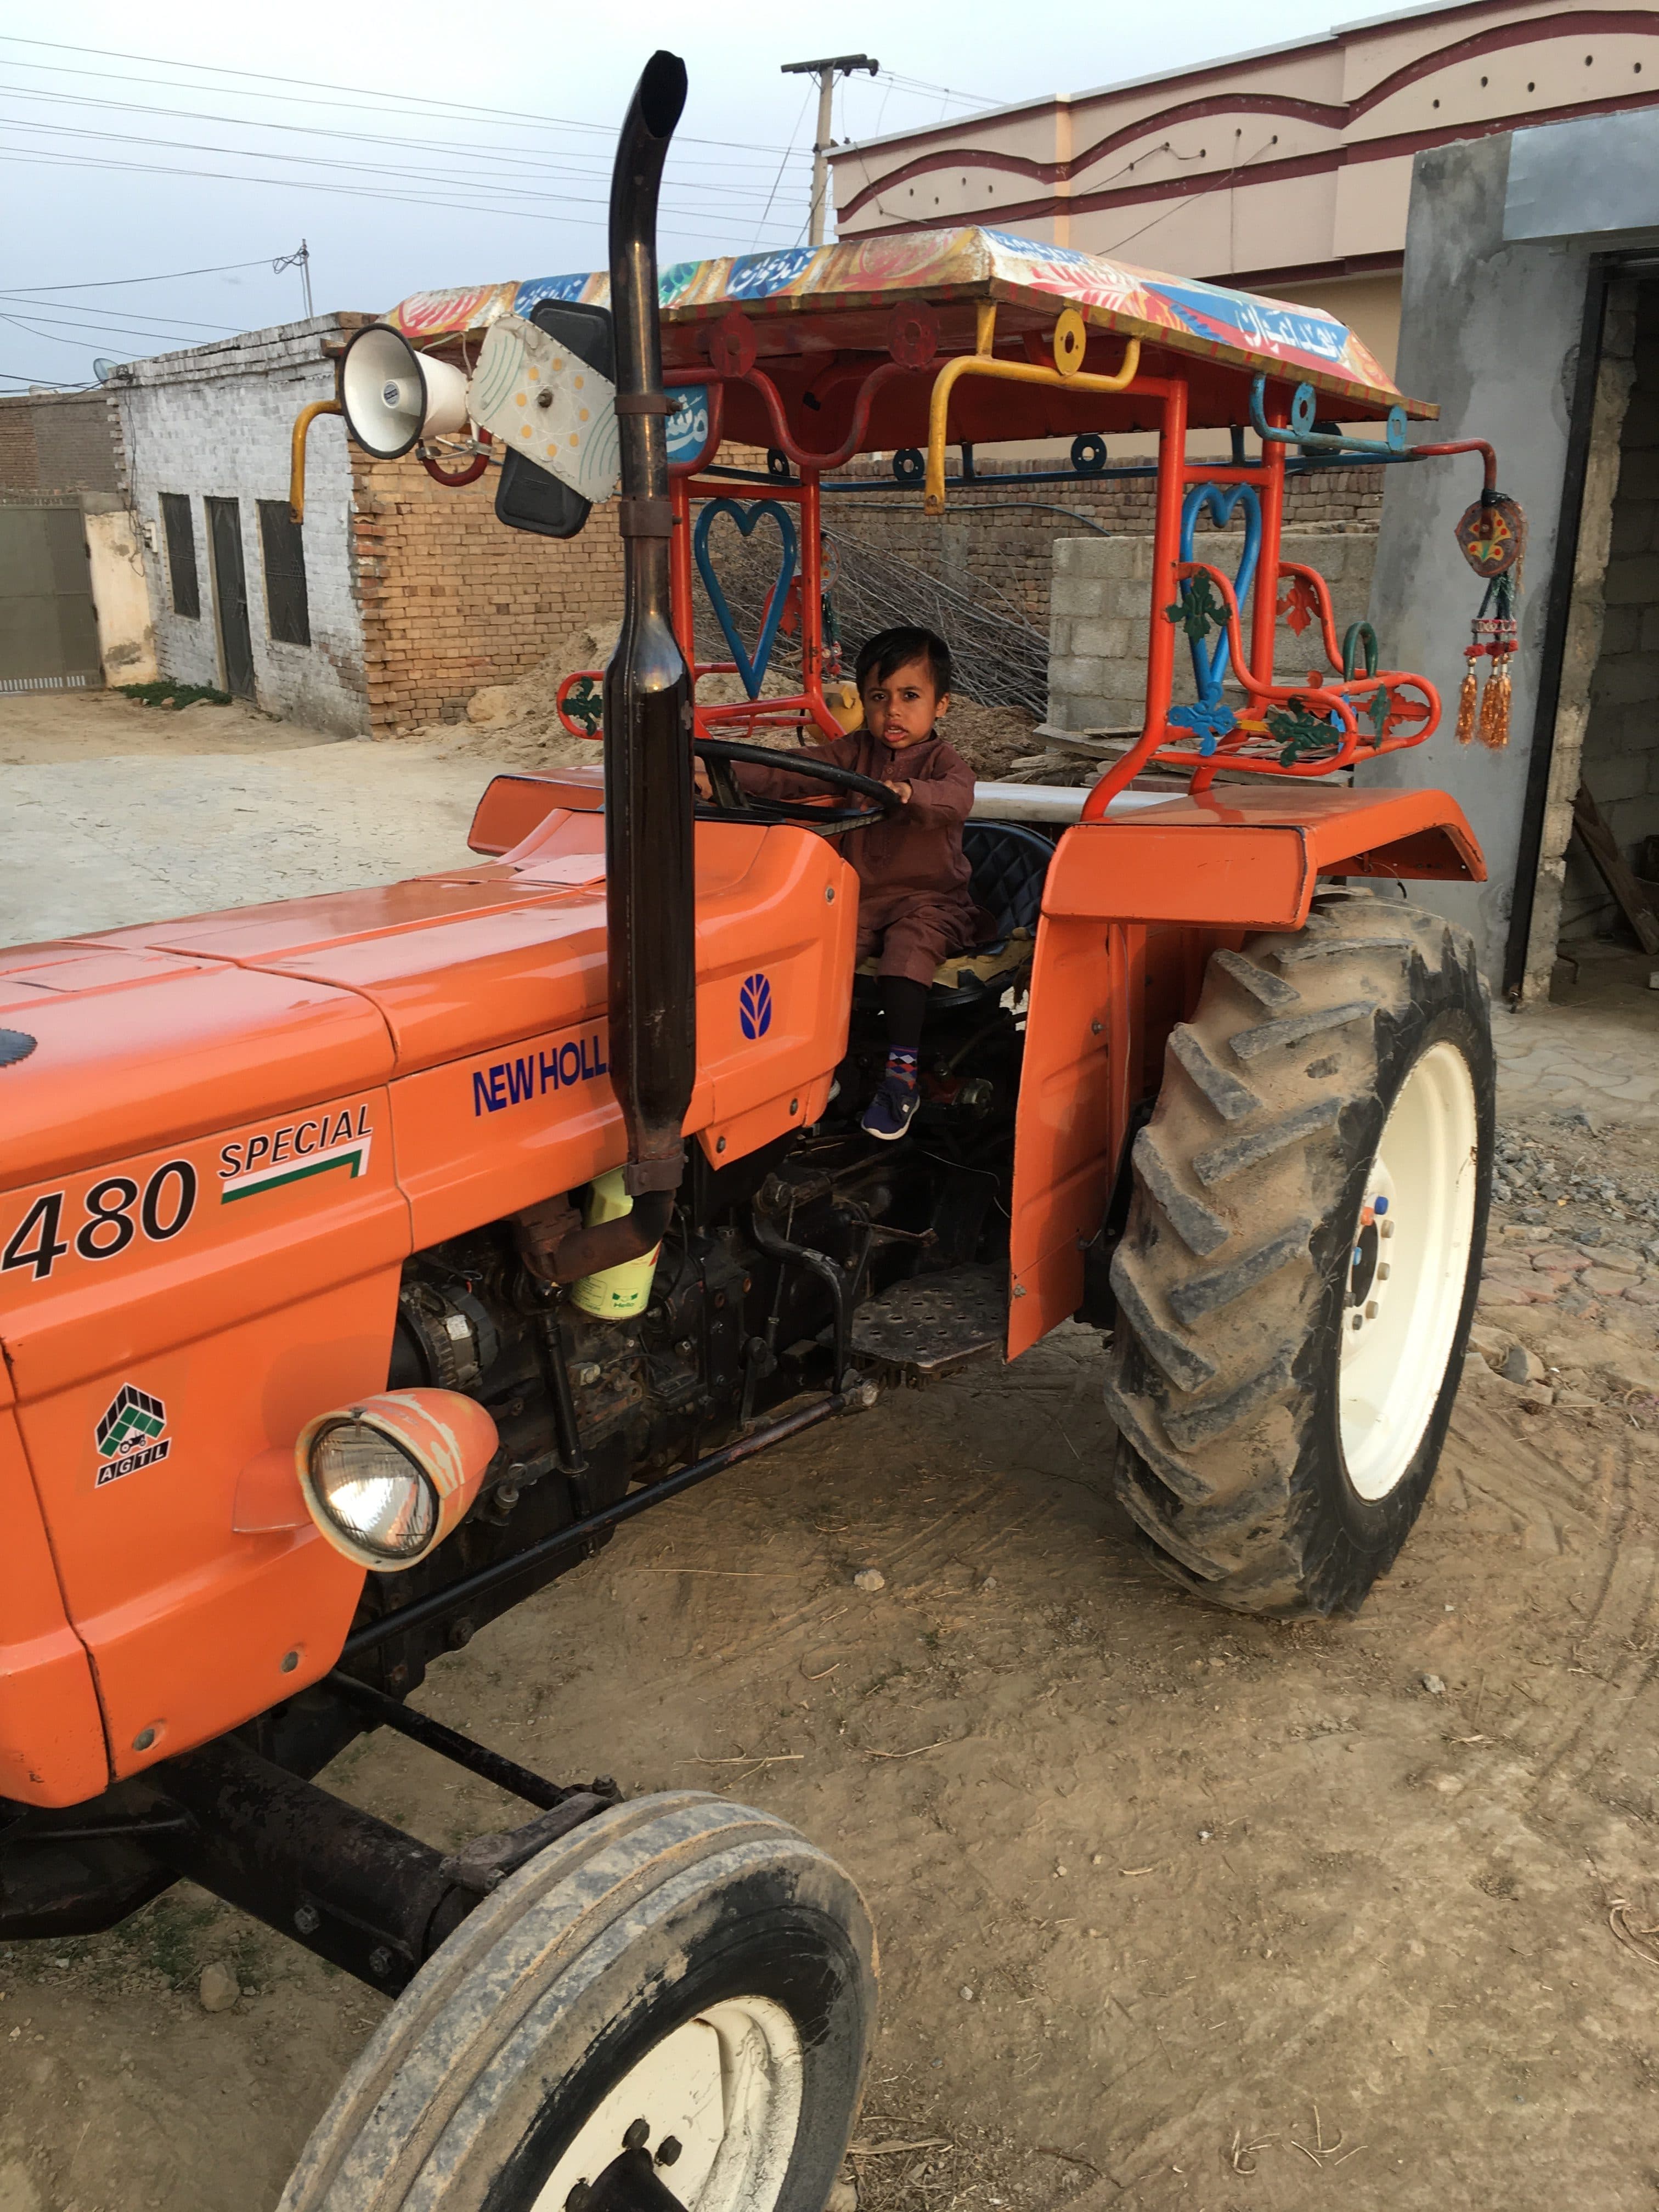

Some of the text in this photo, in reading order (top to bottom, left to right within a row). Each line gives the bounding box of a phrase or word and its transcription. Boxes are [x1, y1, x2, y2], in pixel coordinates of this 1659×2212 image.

[472, 1035, 607, 1117] NEW HOLL
[218, 1104, 373, 1179] SPECIAL
[0, 1159, 198, 1282] 480
[100, 1446, 165, 1482] AGTL
